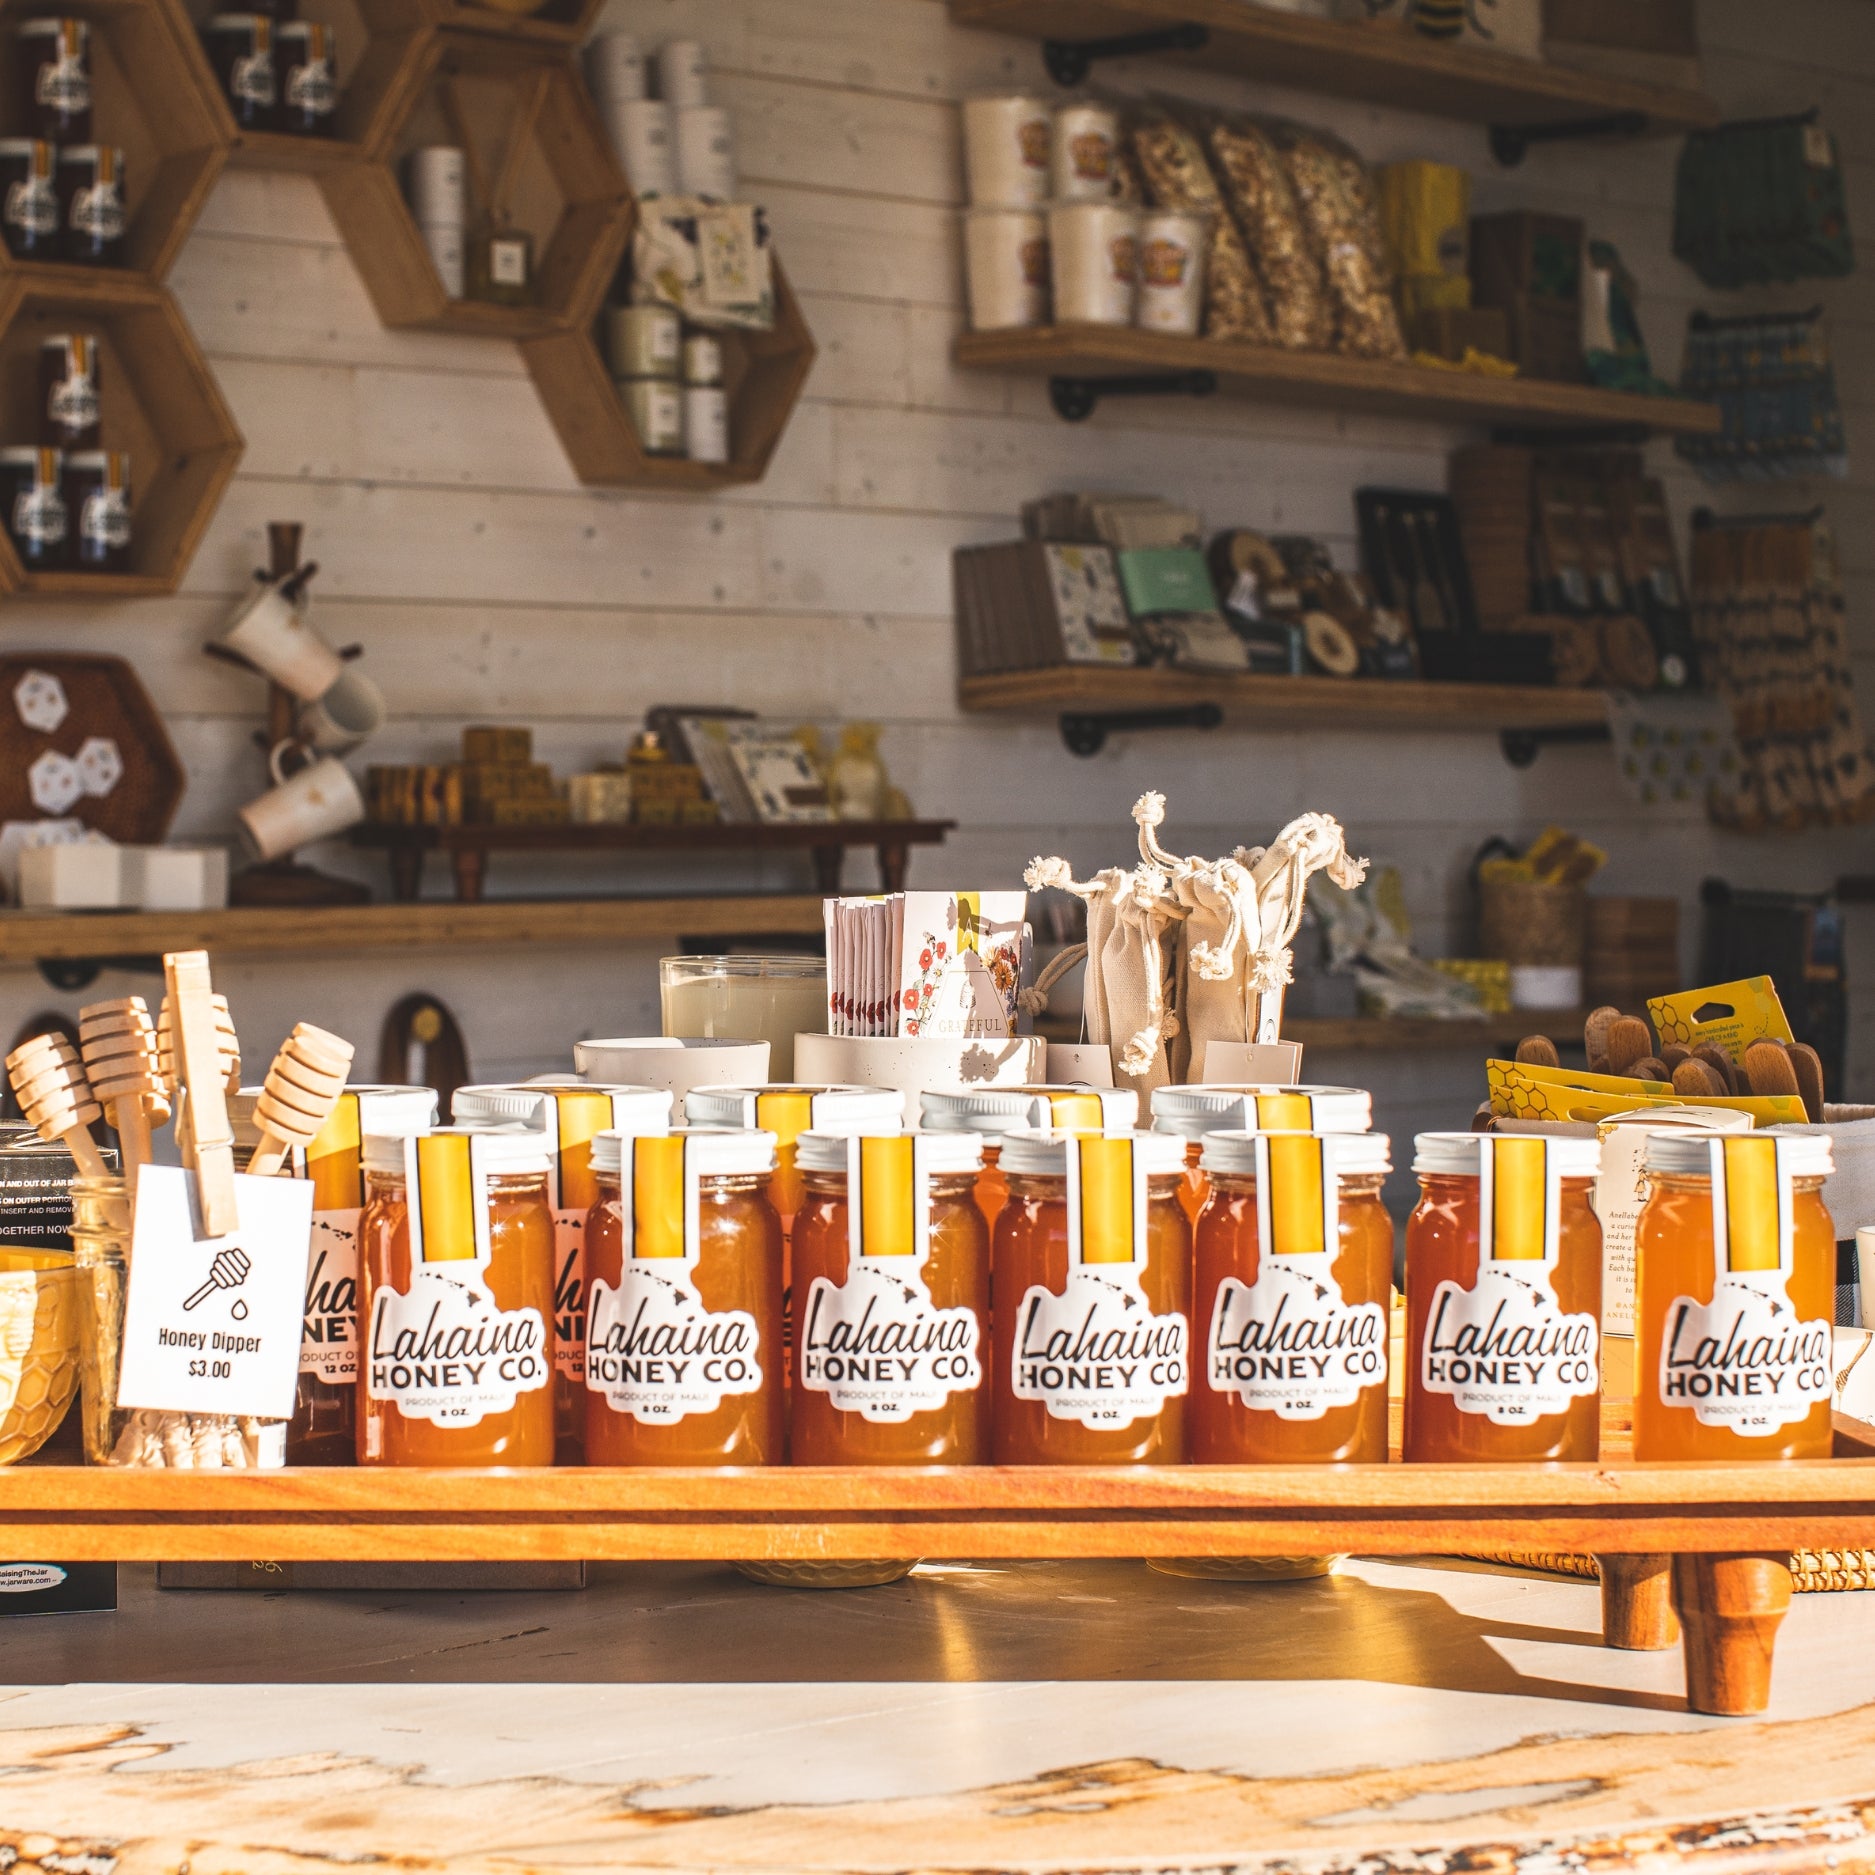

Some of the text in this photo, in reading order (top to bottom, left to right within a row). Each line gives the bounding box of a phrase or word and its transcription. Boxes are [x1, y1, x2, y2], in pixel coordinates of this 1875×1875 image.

[938, 1019, 1002, 1033] GRATEFUL
[52, 1179, 67, 1187] JAR
[1609, 1211, 1639, 1219] Anellabe
[0, 1226, 44, 1235] GETHER
[589, 1289, 749, 1356] Lahaina
[807, 1287, 971, 1355] Lahaina
[1216, 1288, 1378, 1353] Lahaina
[1430, 1290, 1590, 1357] Lahaina
[1606, 1311, 1636, 1320] ANELL
[374, 1297, 537, 1361] Lahaina
[1021, 1296, 1182, 1363] Lahaina
[1668, 1304, 1825, 1370] Lahaina
[159, 1327, 262, 1354] Honey Dipper
[301, 1351, 341, 1362] ODUCT
[188, 1360, 231, 1379] $3.00
[325, 1364, 336, 1373] 12
[373, 1356, 541, 1388] HONEY CO.
[588, 1355, 753, 1383] HONEY CO.
[806, 1355, 974, 1381] HONEY CO.
[1019, 1365, 1137, 1389] HONEY
[1215, 1355, 1331, 1381] HONEY
[1428, 1358, 1546, 1384] HONEY
[1667, 1371, 1785, 1397] HONEY
[405, 1397, 455, 1406] PRODUCT
[612, 1391, 658, 1401] PRODUCT
[662, 1393, 675, 1401] OF
[837, 1390, 886, 1400] PRODUCT
[890, 1391, 904, 1399] OF
[1056, 1398, 1107, 1408] PRODUCT
[451, 1409, 469, 1417] OZ.
[642, 1405, 671, 1413] 8 OZ.
[1285, 1401, 1292, 1409] 8
[0, 1569, 48, 1577] aisingTheJar
